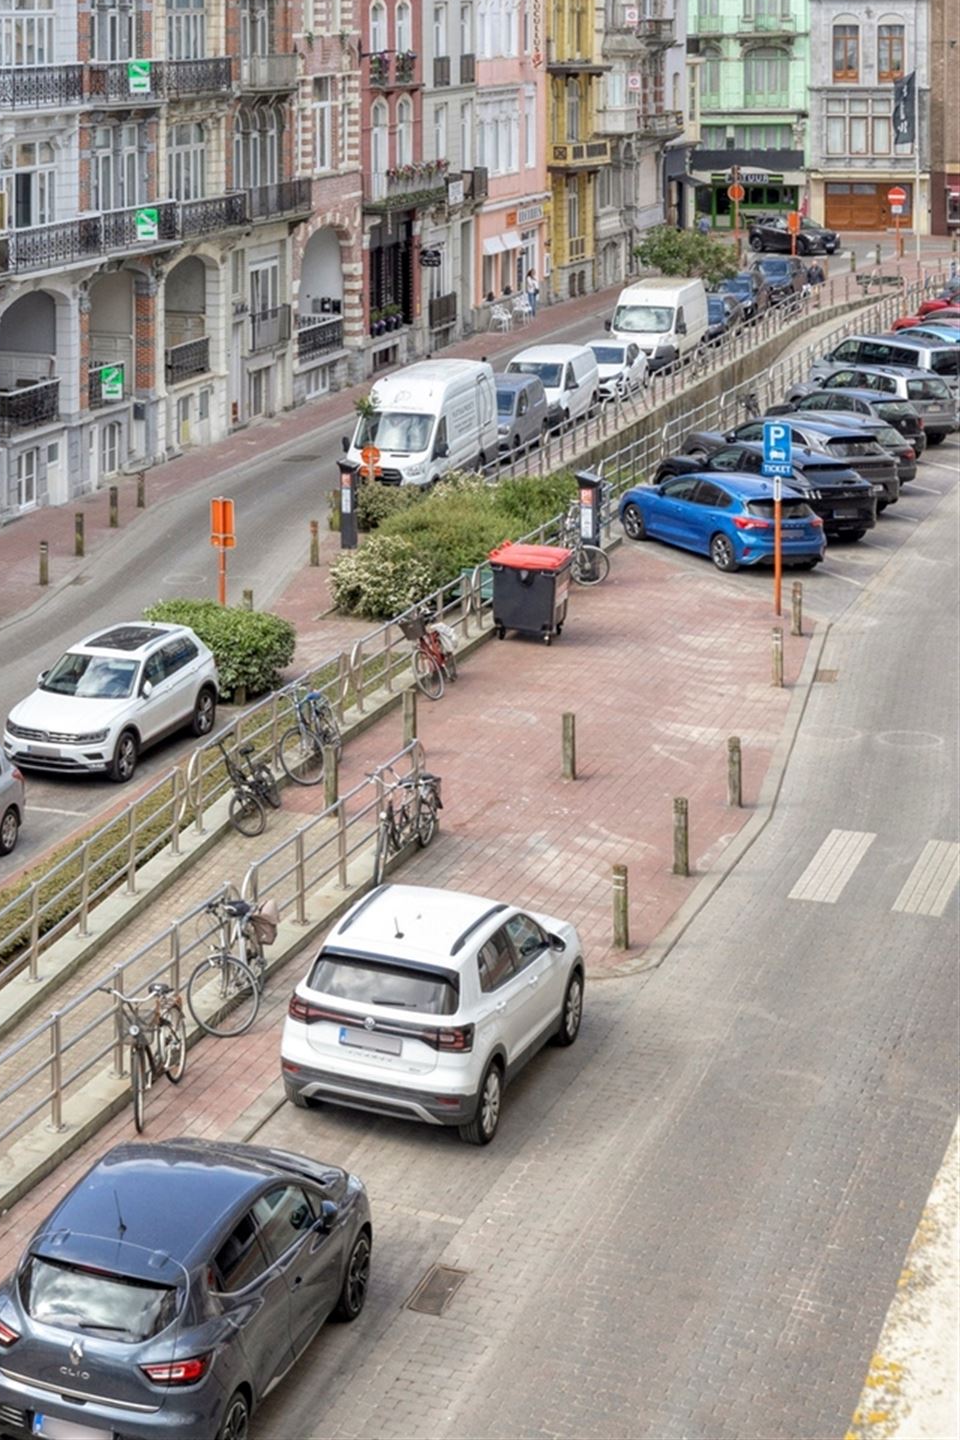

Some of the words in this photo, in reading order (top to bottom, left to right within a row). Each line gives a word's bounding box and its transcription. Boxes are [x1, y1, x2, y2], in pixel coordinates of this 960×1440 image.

[770, 426, 785, 447] P
[764, 464, 791, 473] TICKET
[59, 1366, 90, 1380] CLIO
